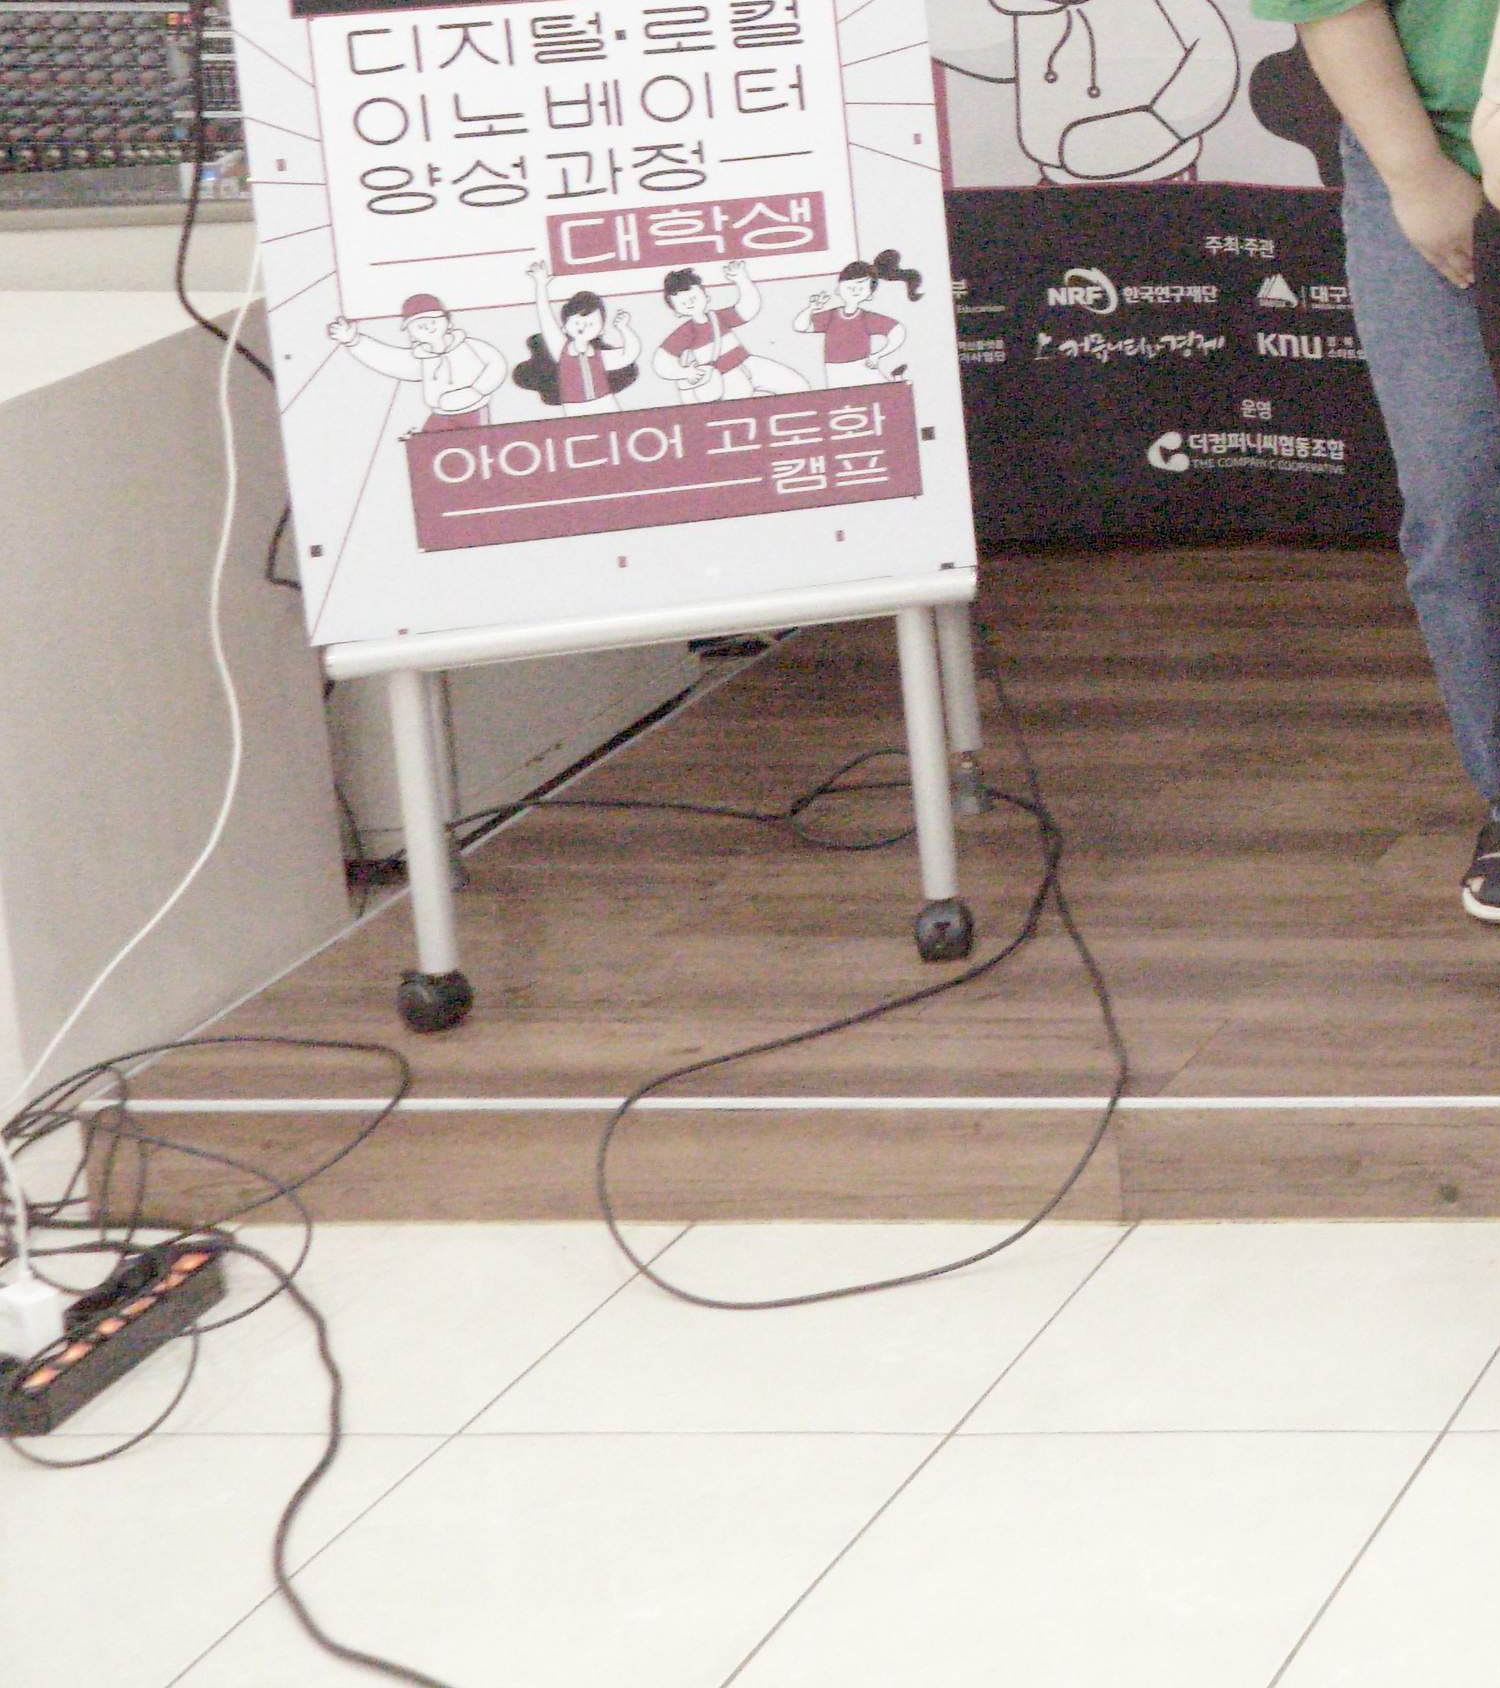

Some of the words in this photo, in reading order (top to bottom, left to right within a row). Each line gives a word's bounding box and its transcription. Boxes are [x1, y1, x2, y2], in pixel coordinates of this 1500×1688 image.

[352, 64, 805, 147] 이노베이터
[360, 142, 709, 216] 양성과정
[559, 196, 813, 266] 대학생
[1048, 286, 1106, 307] NRF
[1123, 285, 1218, 304] 한국연구재단
[1240, 398, 1272, 420] 운영
[431, 429, 686, 485] 아이디어
[705, 403, 886, 457] 고도화
[1189, 433, 1345, 460] 더컴퍼니씨협동조합
[772, 450, 888, 495] 캠프
